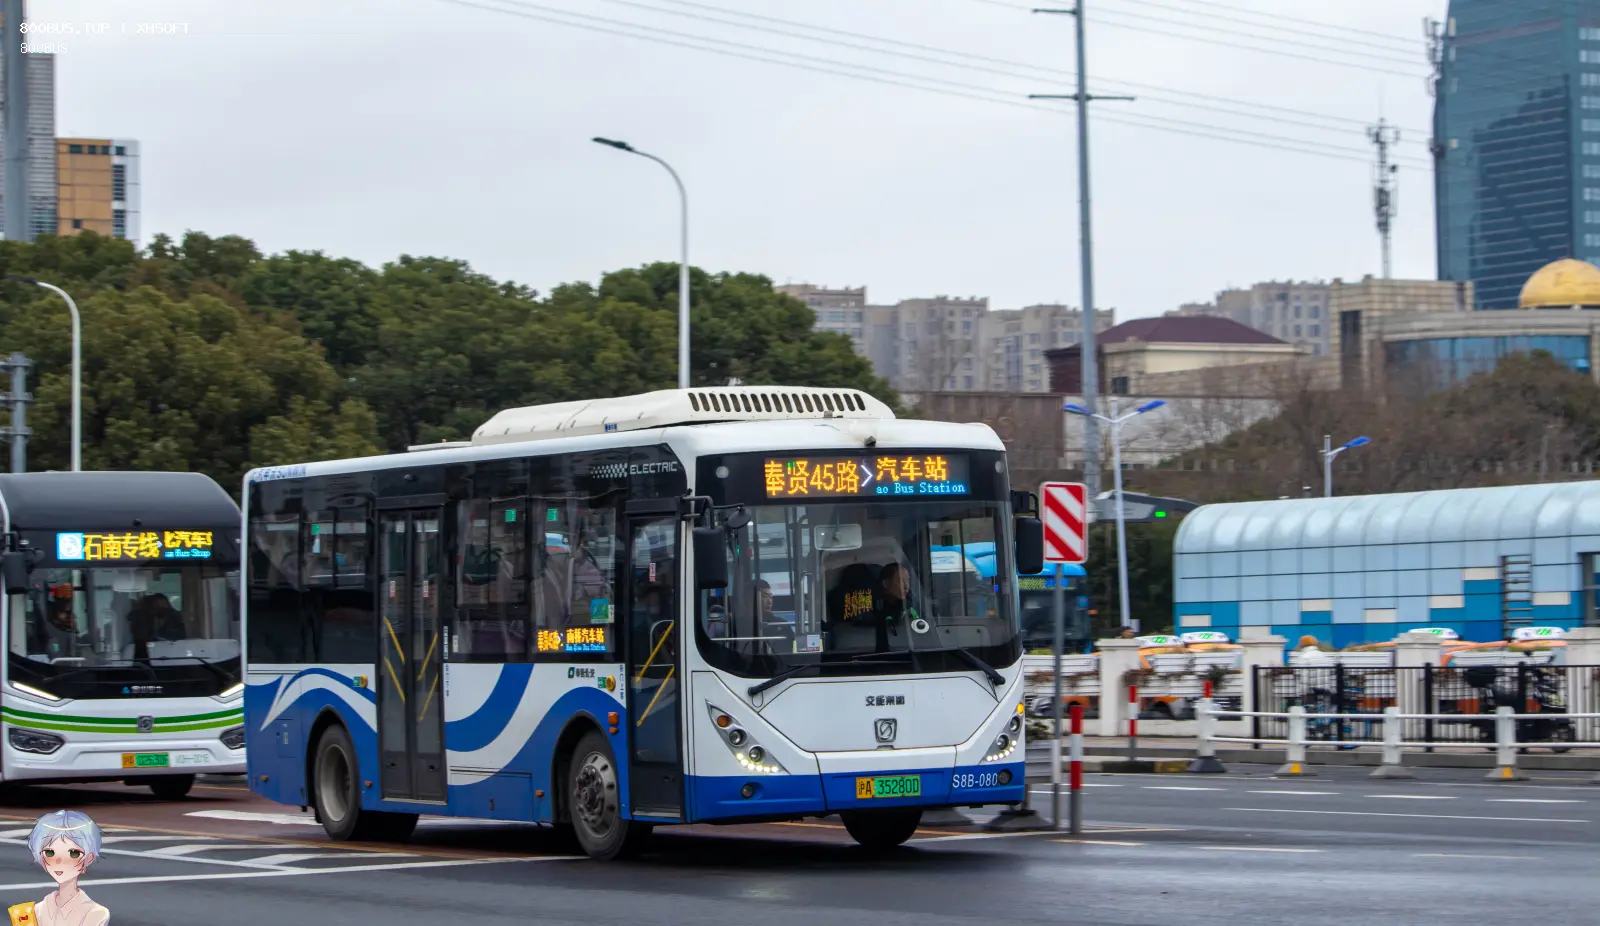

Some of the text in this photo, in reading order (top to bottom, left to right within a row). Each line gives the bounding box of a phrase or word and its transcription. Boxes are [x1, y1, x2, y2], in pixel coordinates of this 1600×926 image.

[629, 461, 678, 474] ELECTRIC
[764, 456, 948, 496] 奉贤45路 汽车站
[895, 483, 914, 494] Bus
[919, 481, 966, 493] Station
[83, 533, 160, 560] 石南专线
[952, 773, 998, 788] S8B-080
